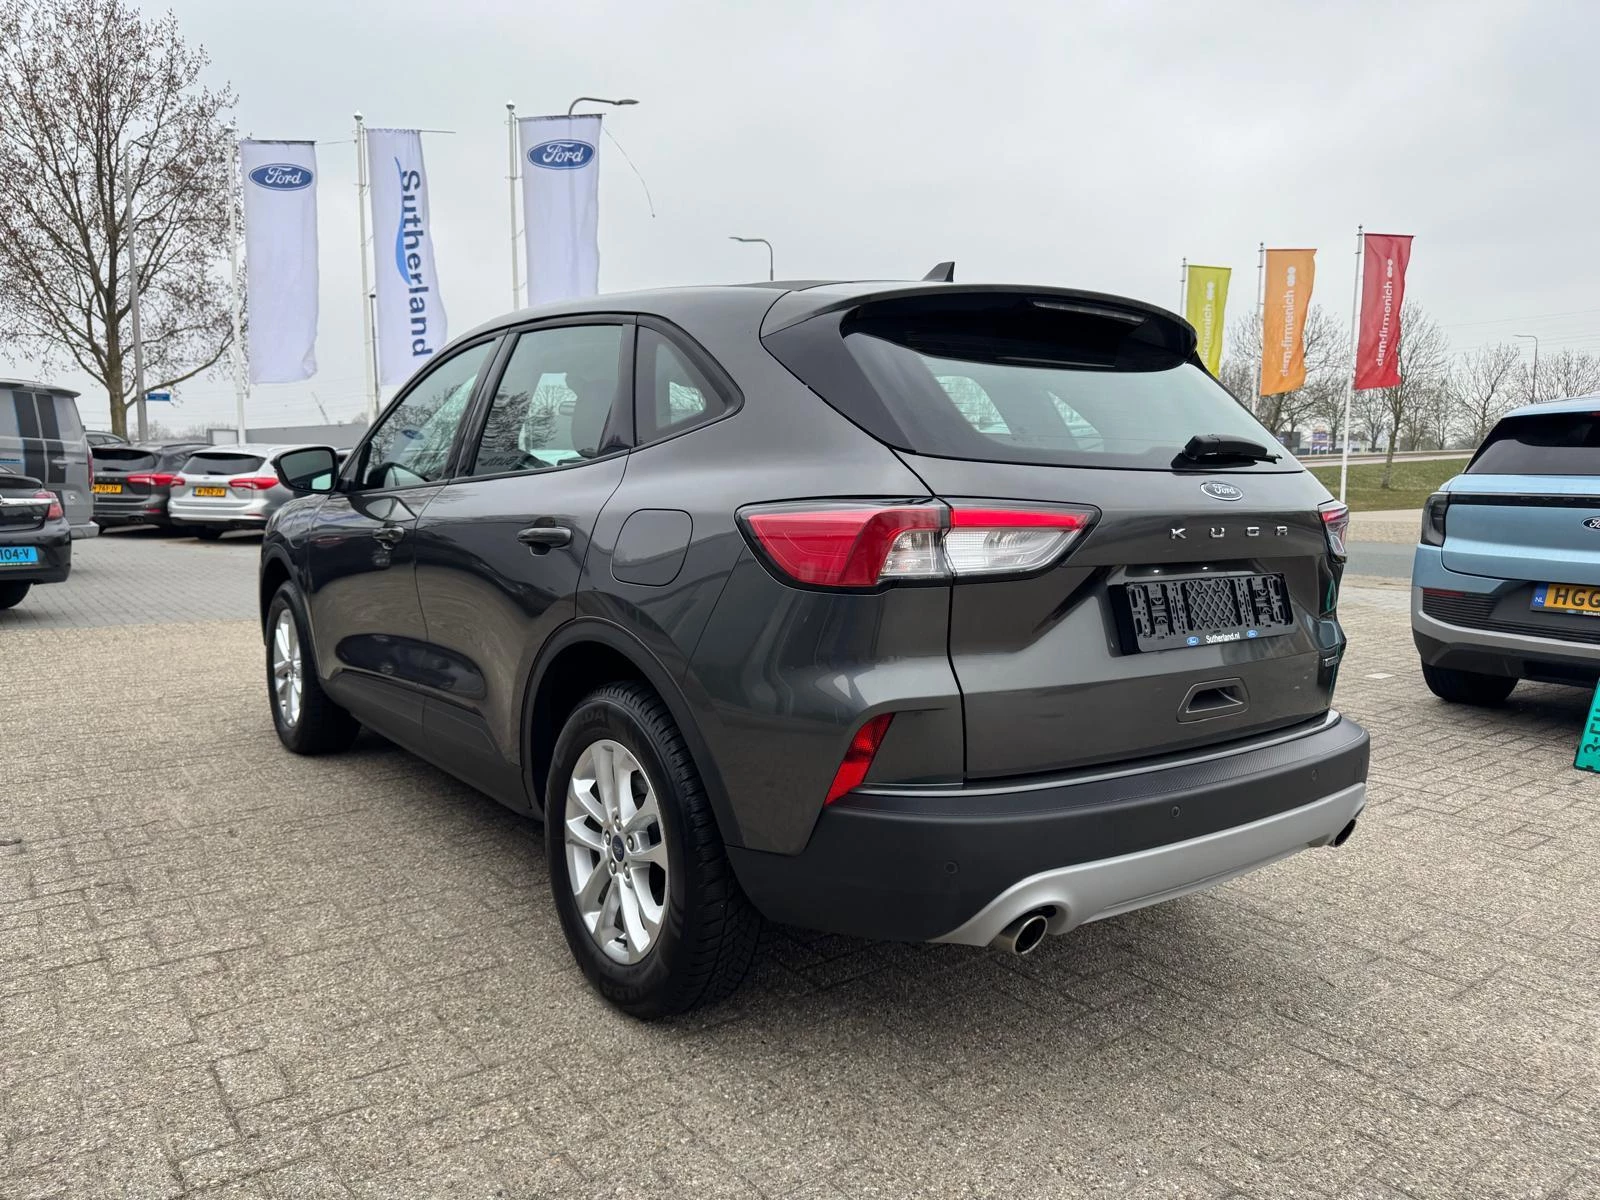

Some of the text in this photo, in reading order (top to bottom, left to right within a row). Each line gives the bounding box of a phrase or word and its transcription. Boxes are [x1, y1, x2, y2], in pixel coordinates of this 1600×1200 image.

[542, 143, 584, 162] Ford
[264, 166, 302, 183] Ford
[401, 170, 433, 357] Sutherland
[1212, 483, 1236, 494] Ford
[1170, 525, 1288, 540] KUGA
[1553, 587, 1600, 608] HGG
[1206, 632, 1240, 644] Sutherland.nl
